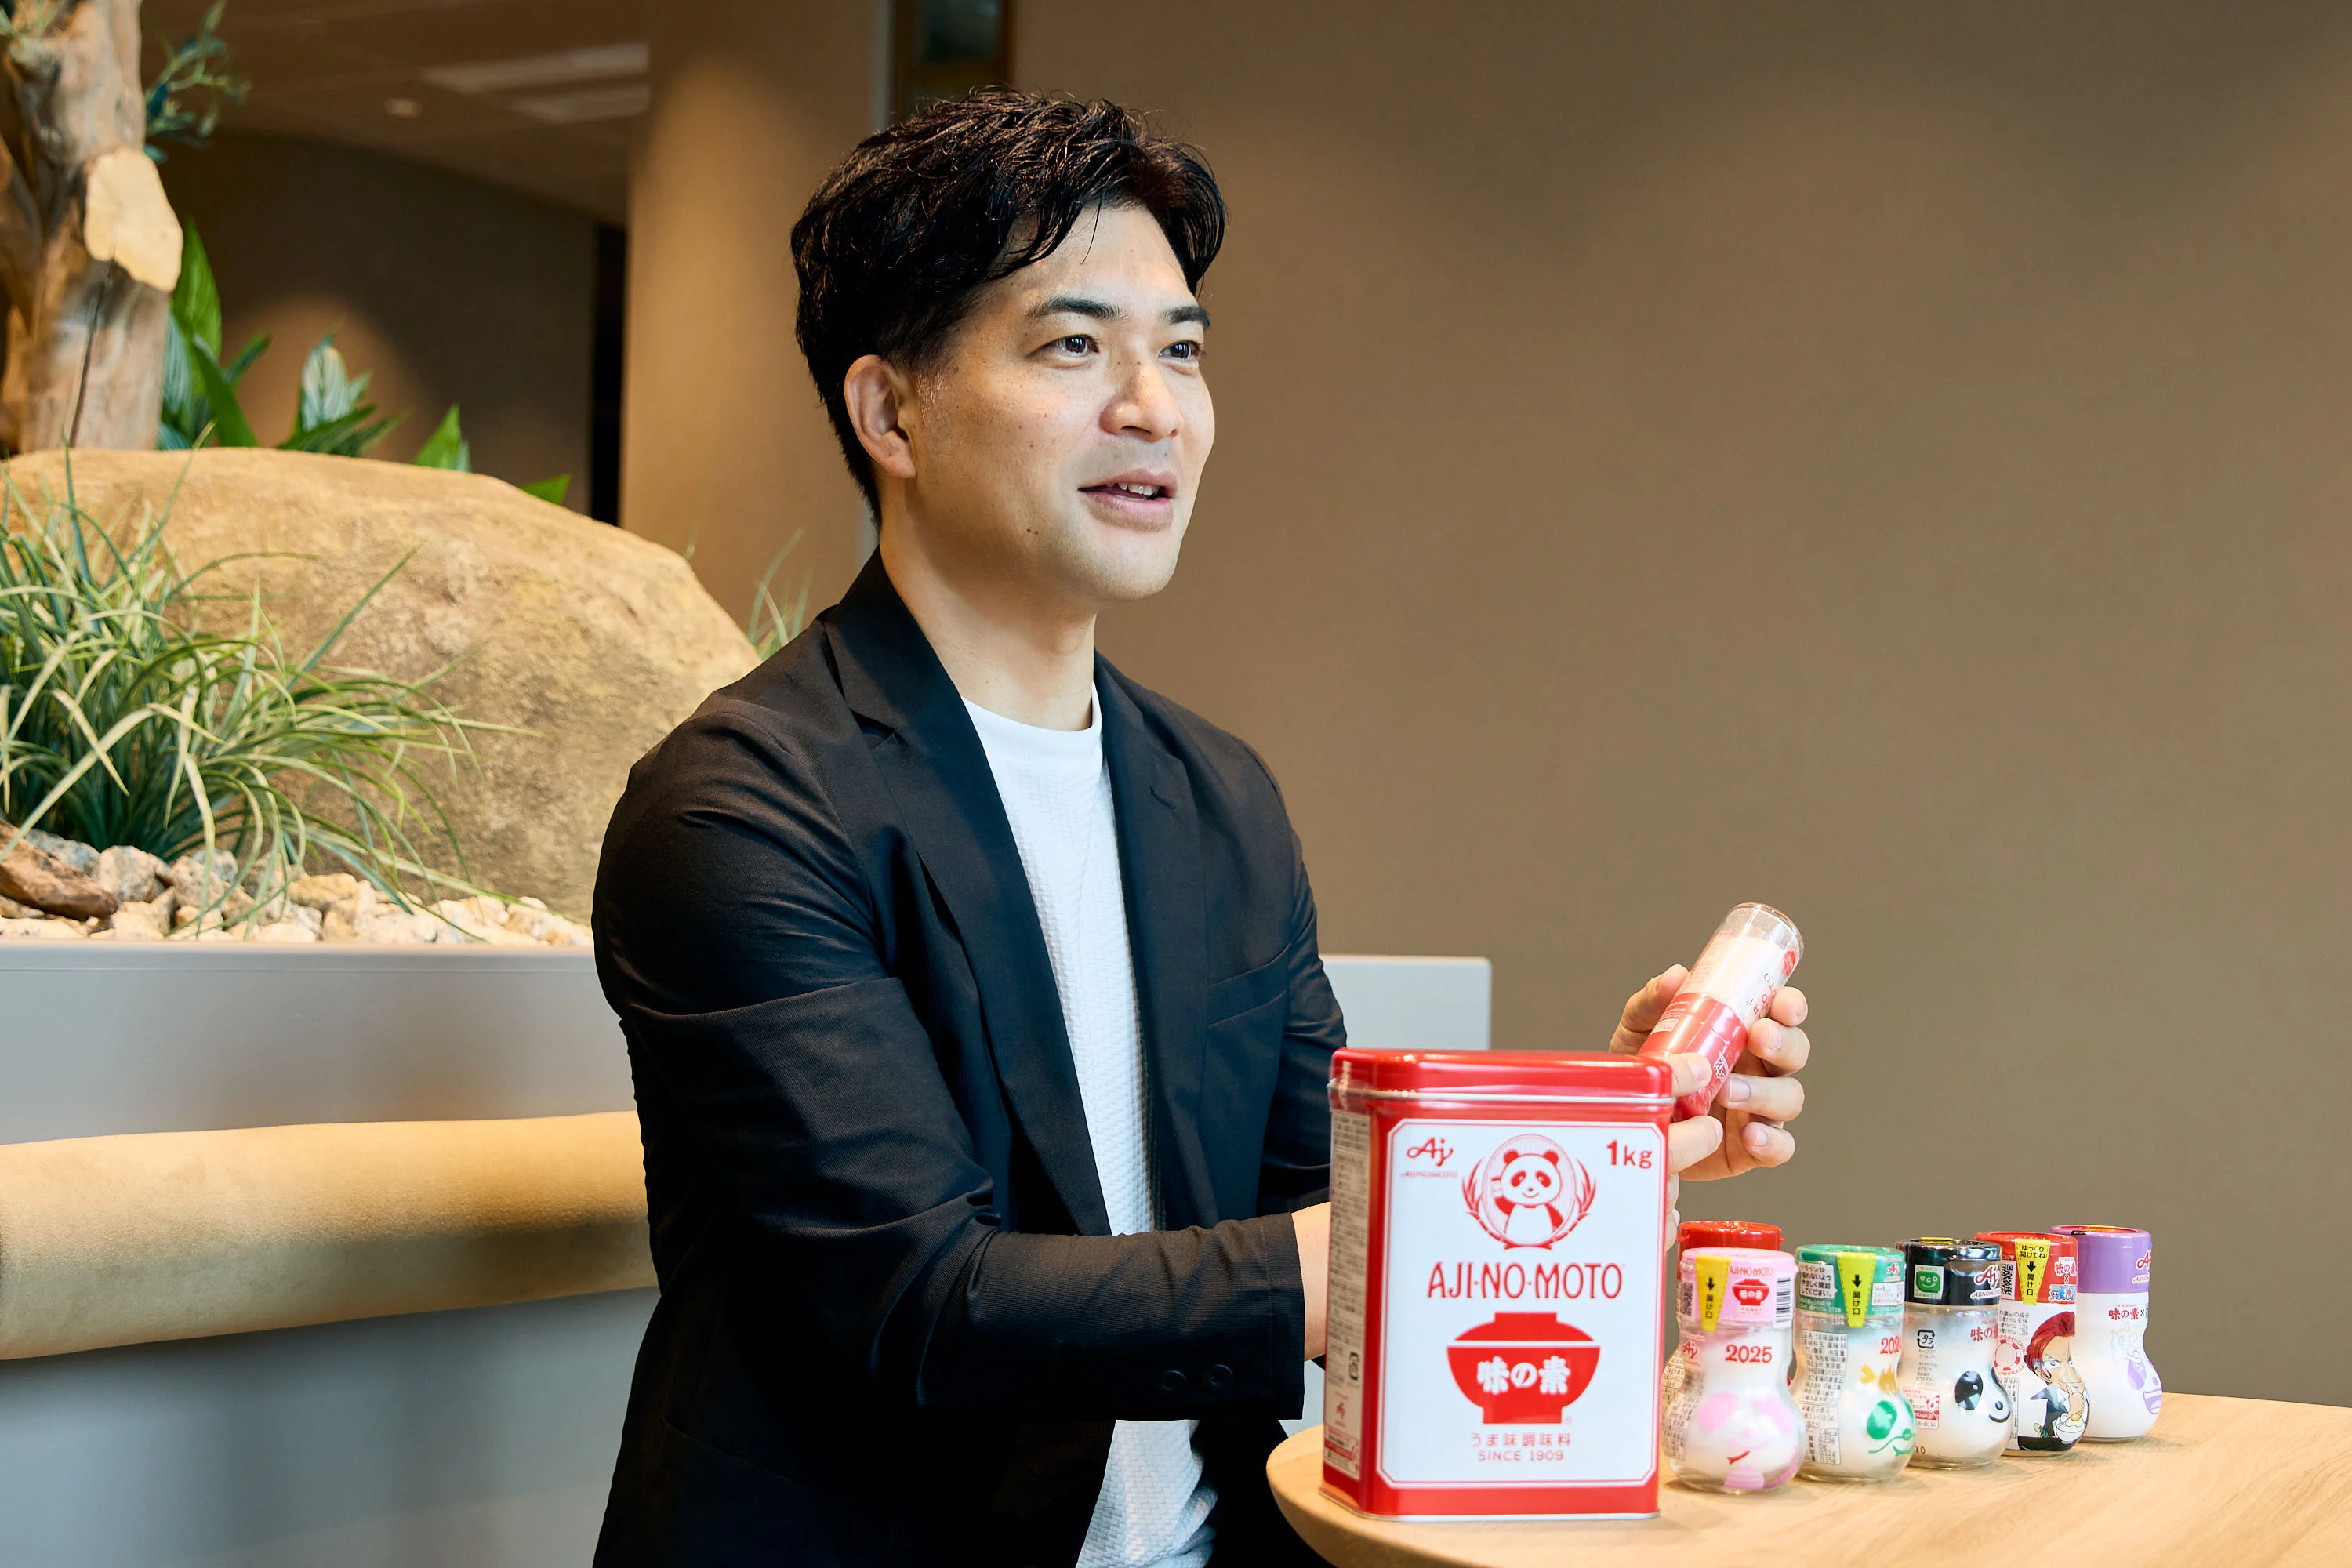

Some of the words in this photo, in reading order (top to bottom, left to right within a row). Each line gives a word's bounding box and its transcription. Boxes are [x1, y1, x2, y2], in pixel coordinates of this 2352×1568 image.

[1406, 1137, 1454, 1167] Aj
[1606, 1140, 1652, 1169] 1kg
[1725, 1344, 1773, 1363] 2025
[1477, 1356, 1570, 1395] 味の素
[1471, 1432, 1571, 1447] うま味調味料
[1479, 1450, 1522, 1461] SINCE
[1530, 1450, 1564, 1461] 1909
